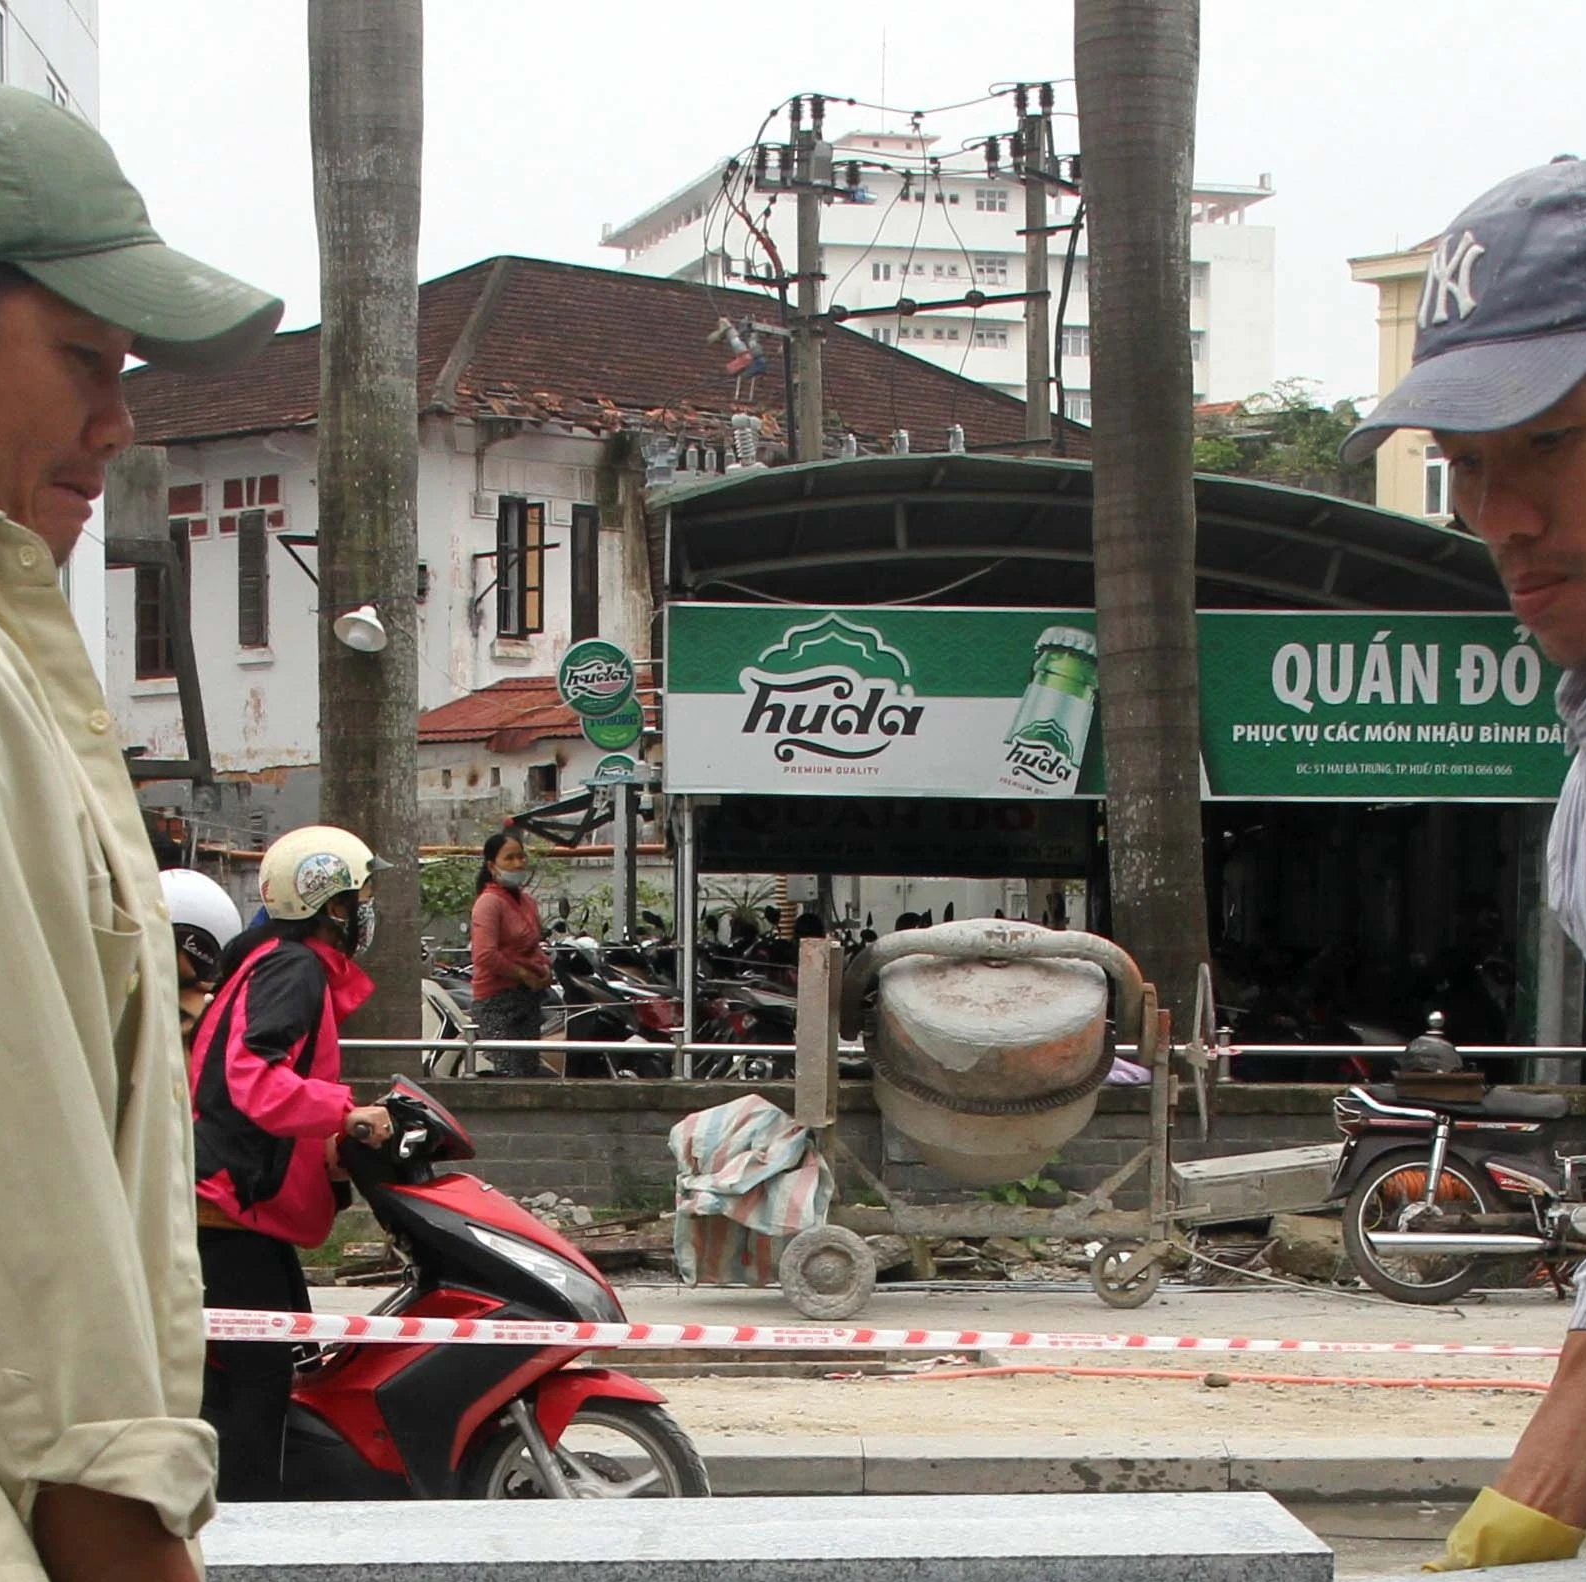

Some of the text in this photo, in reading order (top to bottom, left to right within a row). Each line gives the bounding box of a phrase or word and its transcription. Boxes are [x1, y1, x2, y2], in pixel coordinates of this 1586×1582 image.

[566, 660, 630, 688] huda
[1271, 631, 1438, 713] QUÁN
[741, 676, 925, 736] huda
[1232, 725, 1286, 747] PHỤC
[1291, 725, 1316, 747] VỤ
[1323, 721, 1360, 743] CÁC
[1364, 721, 1409, 743] MÓN
[1416, 723, 1472, 747] NHẬU
[1478, 722, 1529, 743] BÌNH
[784, 767, 879, 775] PREMIUM QUALITY
[1006, 743, 1071, 781] huda
[1313, 764, 1324, 775] 51
[1327, 764, 1342, 775] HAI
[1345, 763, 1357, 775] BÀ
[1450, 764, 1473, 775] 0818
[1475, 764, 1492, 775] 066
[1494, 764, 1512, 775] 066
